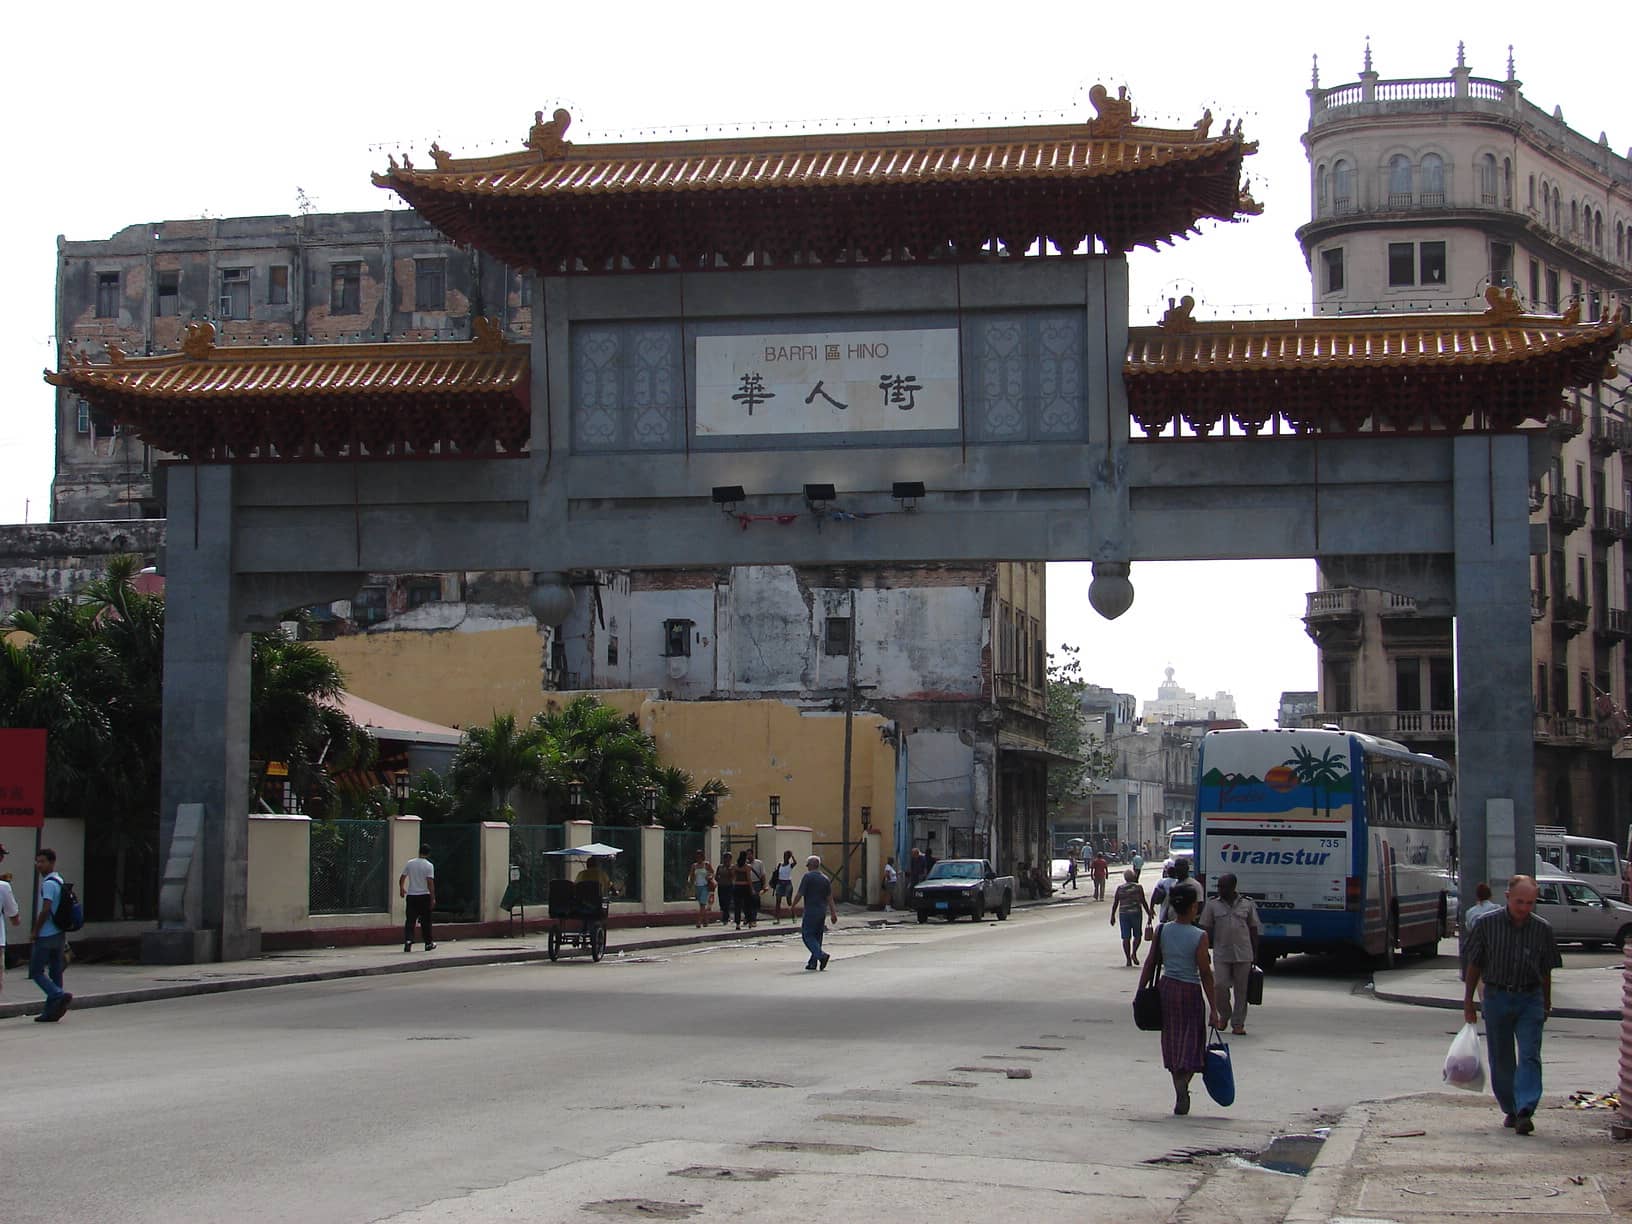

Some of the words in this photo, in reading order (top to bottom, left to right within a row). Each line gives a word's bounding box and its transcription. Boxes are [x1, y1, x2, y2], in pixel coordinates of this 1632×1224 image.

[825, 344, 841, 360] 區
[847, 343, 889, 360] HINO
[731, 373, 923, 416] 華人街
[1320, 839, 1339, 848] 735
[1220, 843, 1331, 866] Transtur
